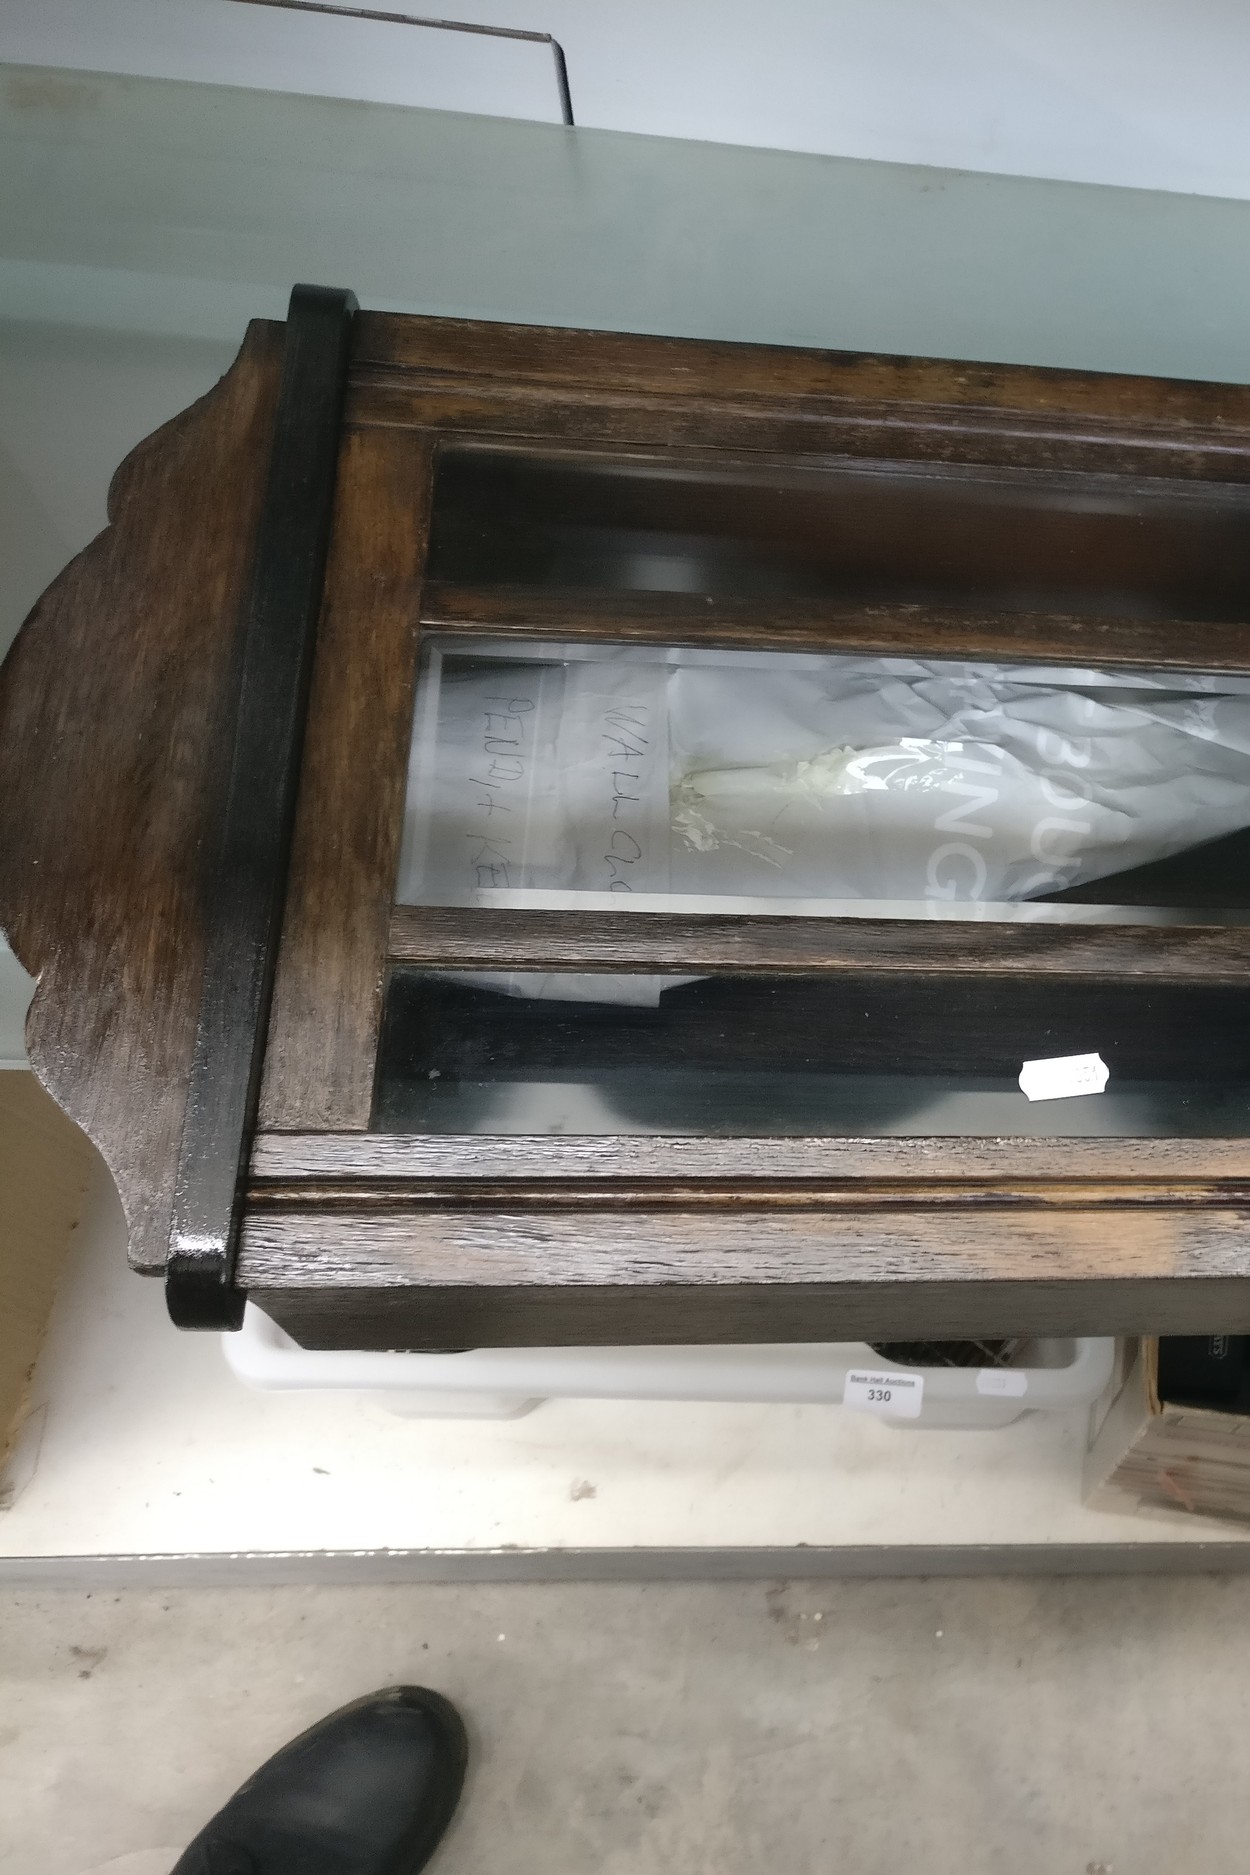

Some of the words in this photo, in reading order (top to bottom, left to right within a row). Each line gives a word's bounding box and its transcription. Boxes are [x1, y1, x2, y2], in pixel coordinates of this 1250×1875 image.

[602, 705, 649, 820] WALL
[850, 1374, 868, 1383] Bank
[884, 1377, 915, 1387] Auctions
[867, 1389, 892, 1402] 330
